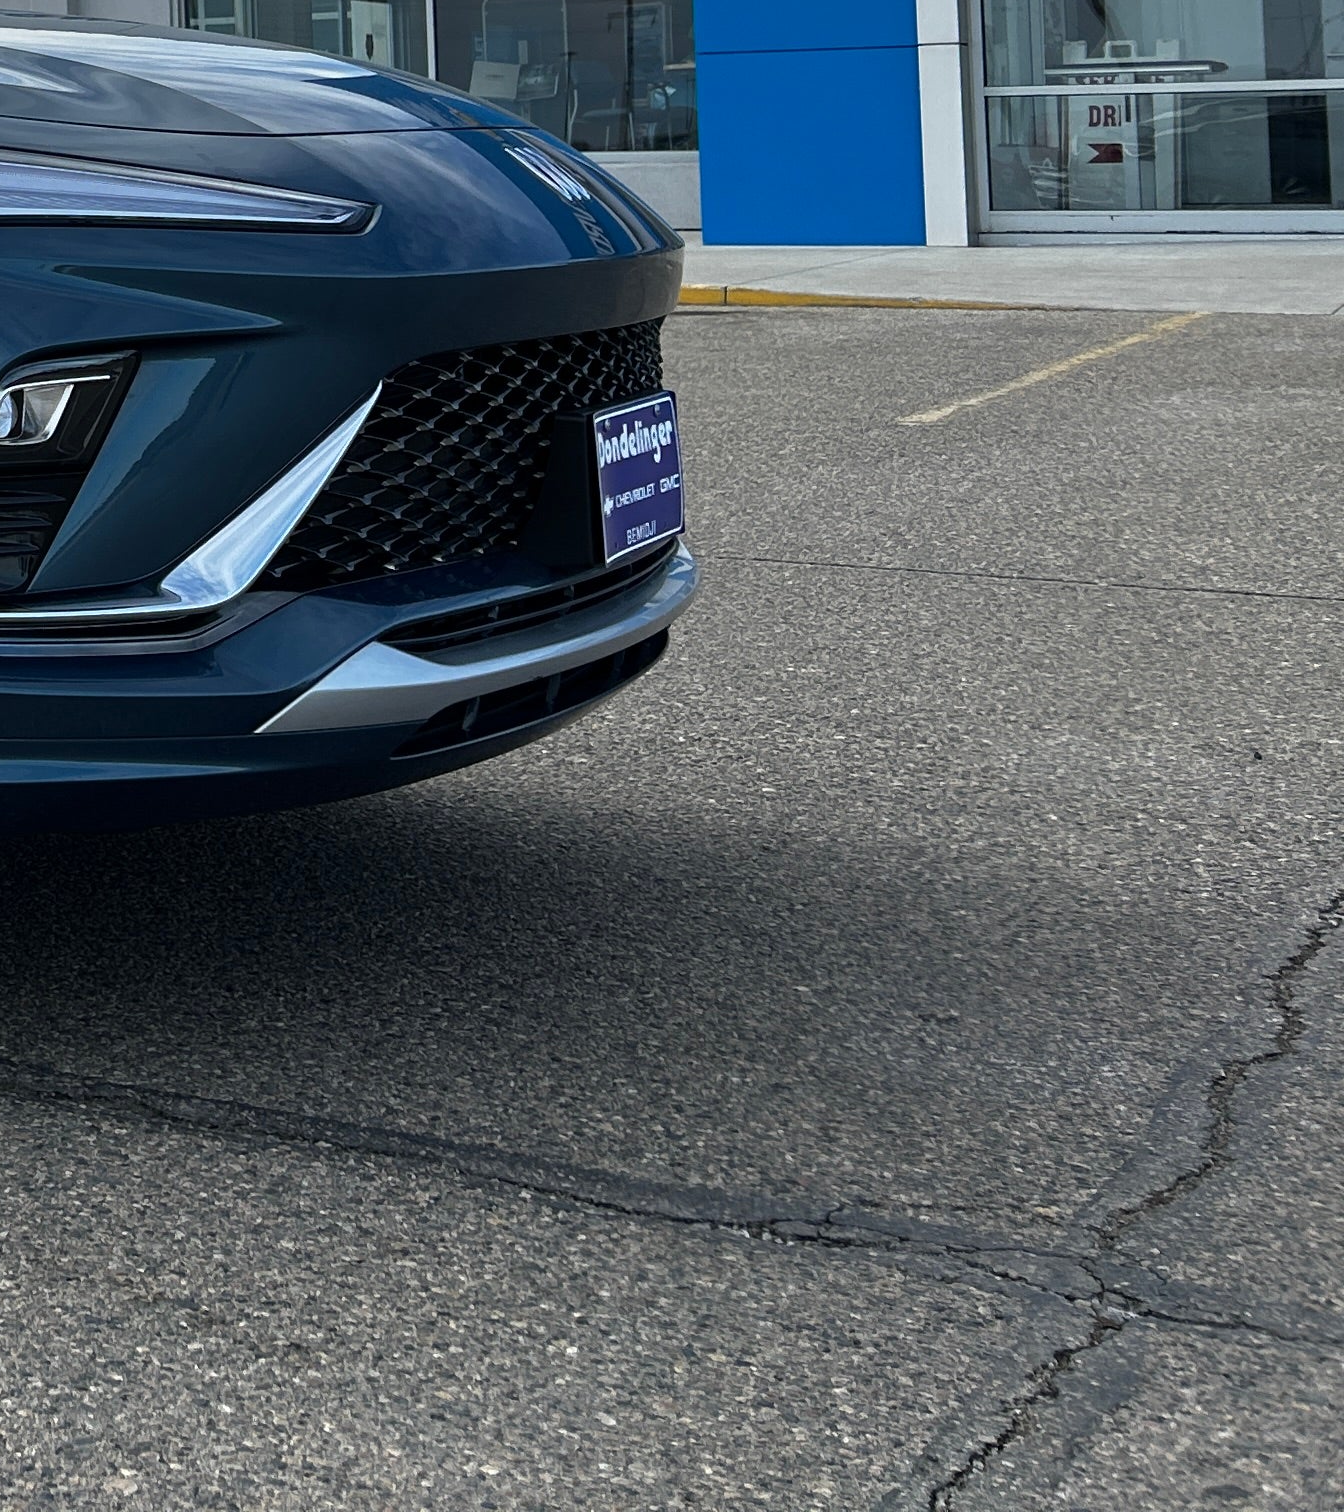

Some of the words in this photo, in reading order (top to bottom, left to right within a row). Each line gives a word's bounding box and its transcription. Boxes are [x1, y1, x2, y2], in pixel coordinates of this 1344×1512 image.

[598, 420, 673, 468] Dondelinger
[615, 482, 656, 508] CHEVROLET
[659, 473, 681, 494] GMC
[626, 520, 657, 545] BEMIDJI
